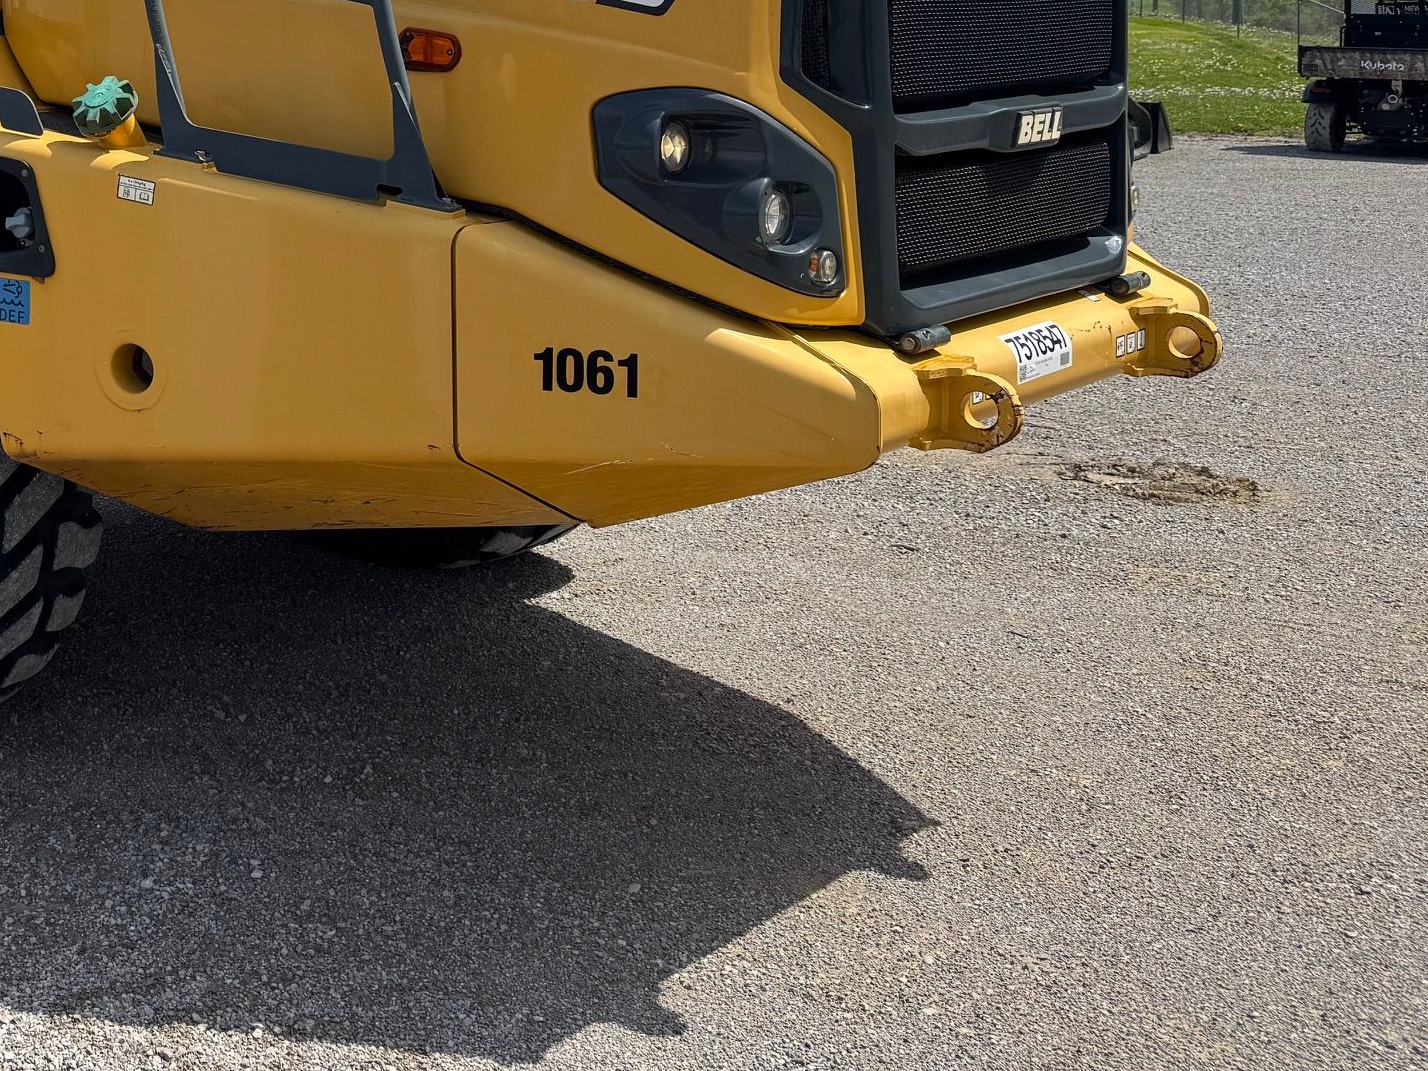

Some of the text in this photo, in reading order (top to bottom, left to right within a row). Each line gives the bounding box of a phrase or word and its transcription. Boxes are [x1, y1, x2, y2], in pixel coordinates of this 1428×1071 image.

[1360, 59, 1405, 71] Kubota
[1017, 111, 1062, 145] BELL
[0, 307, 26, 324] DEF
[1003, 324, 1068, 364] 7518547
[533, 346, 639, 399] 1061
